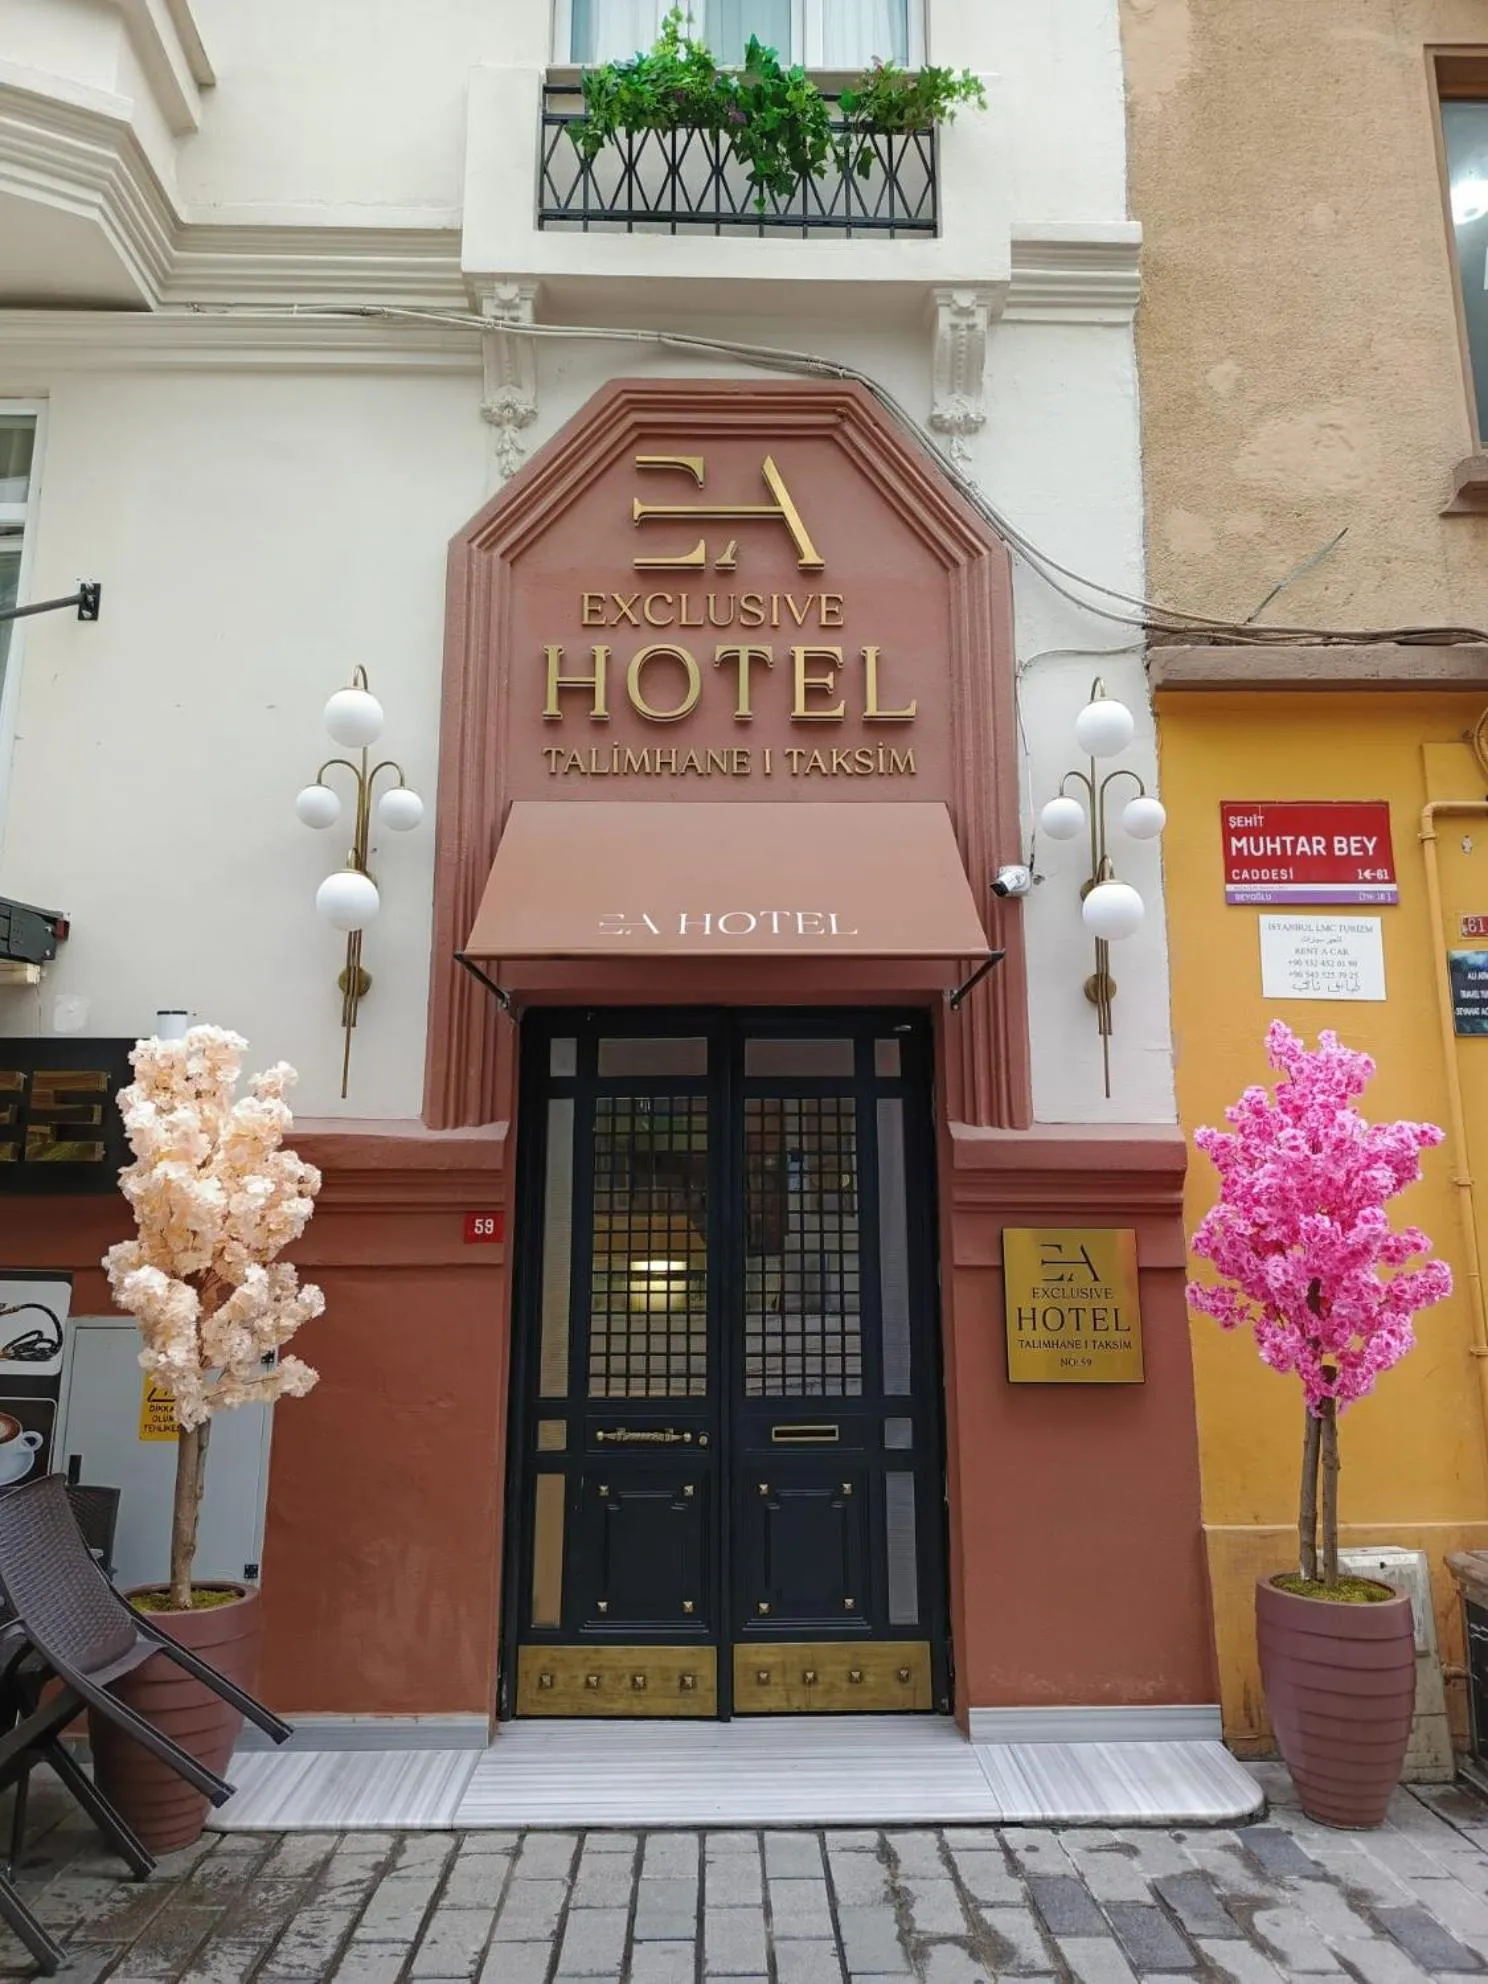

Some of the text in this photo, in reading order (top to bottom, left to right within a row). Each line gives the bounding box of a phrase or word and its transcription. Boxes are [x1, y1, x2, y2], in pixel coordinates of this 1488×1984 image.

[580, 591, 846, 628] EXCLUSIVE
[541, 643, 918, 723] HOTEL
[542, 741, 752, 776] TALİMHANE
[785, 741, 917, 776] TAKSİM
[1228, 814, 1264, 829] ŞEHİT
[1230, 835, 1378, 857] MUHTAR BEY
[1231, 867, 1294, 881] CADDESİ
[678, 910, 859, 936] HOTEL
[474, 1218, 495, 1235] 59
[1032, 1286, 1114, 1300] EXCLUSIVE
[1016, 1306, 1131, 1332] HOTEL
[1080, 1357, 1092, 1367] 59
